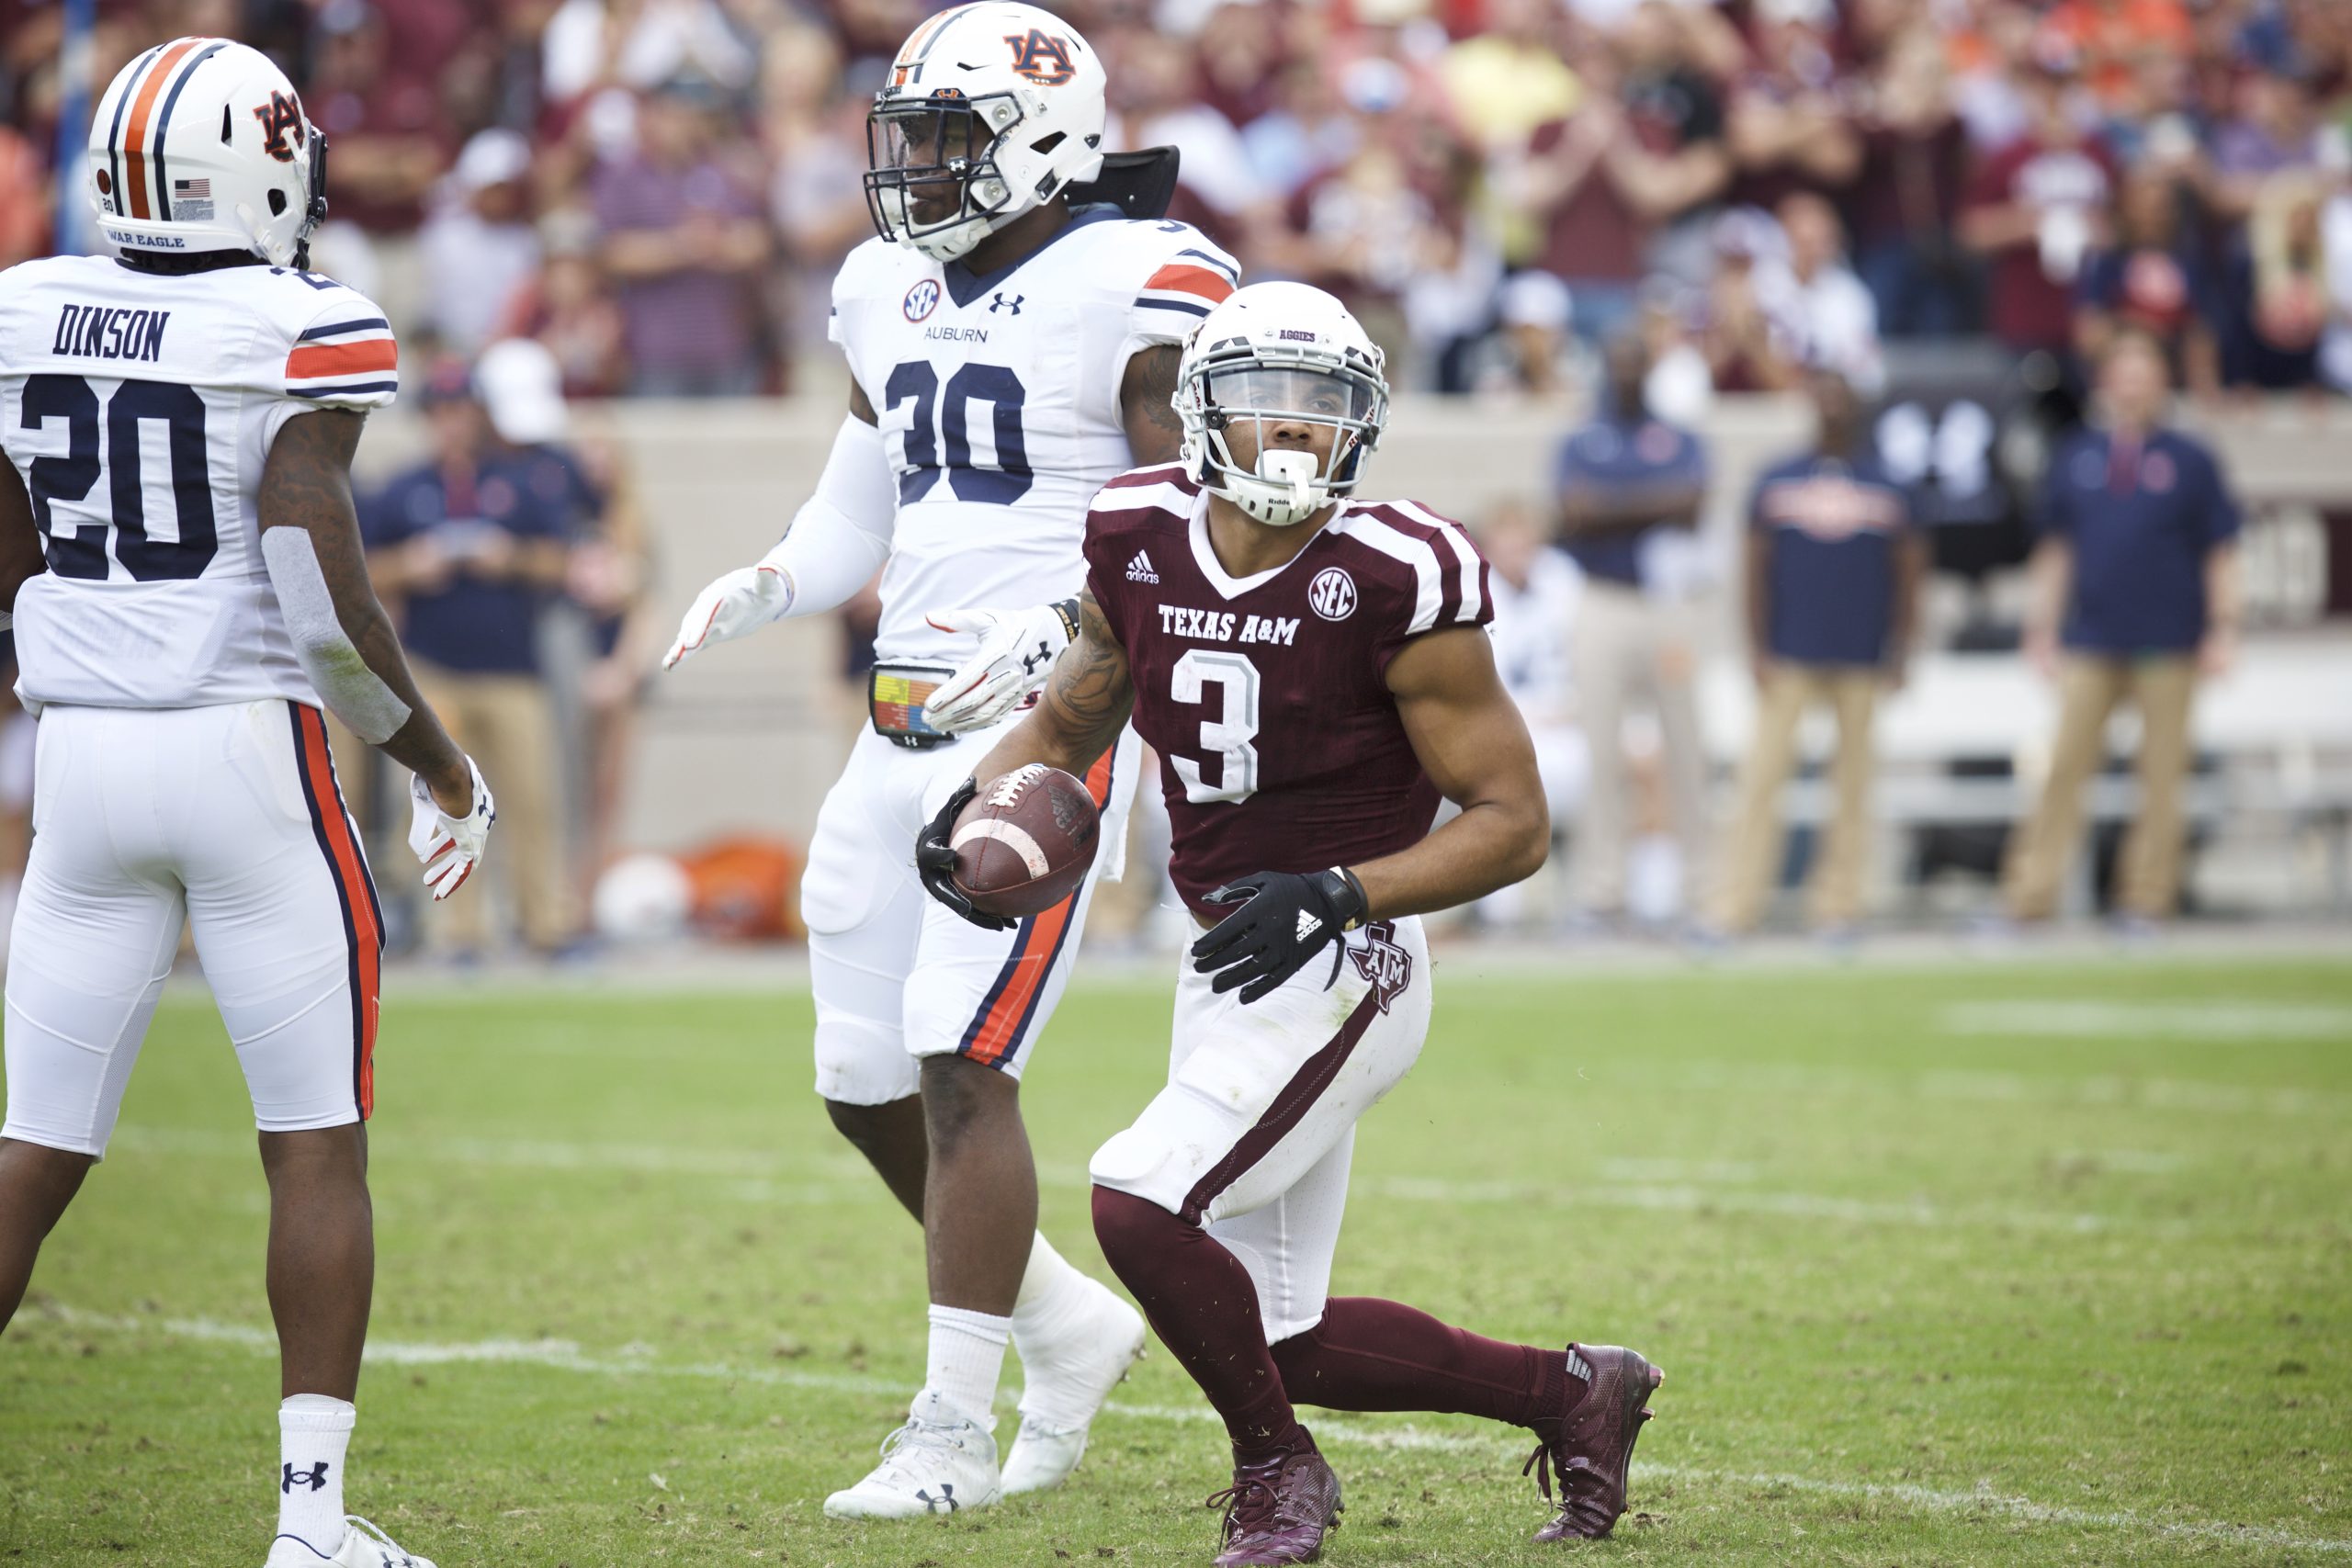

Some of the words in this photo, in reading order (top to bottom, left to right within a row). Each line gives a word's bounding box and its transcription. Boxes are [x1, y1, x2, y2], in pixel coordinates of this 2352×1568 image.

[107, 230, 134, 244] WAR
[136, 235, 185, 248] EAGLE
[52, 304, 170, 362] DINSON
[924, 327, 988, 343] AUBURN
[1279, 329, 1316, 343] AGGIES
[885, 359, 1034, 506] 30
[20, 374, 219, 581] 20
[1125, 567, 1159, 584] adidas
[1312, 570, 1353, 618] SEC
[1159, 604, 1236, 642] TEXAS
[1238, 615, 1301, 647] A&M
[1170, 648, 1261, 805] 3
[1295, 918, 1323, 942] adidas
